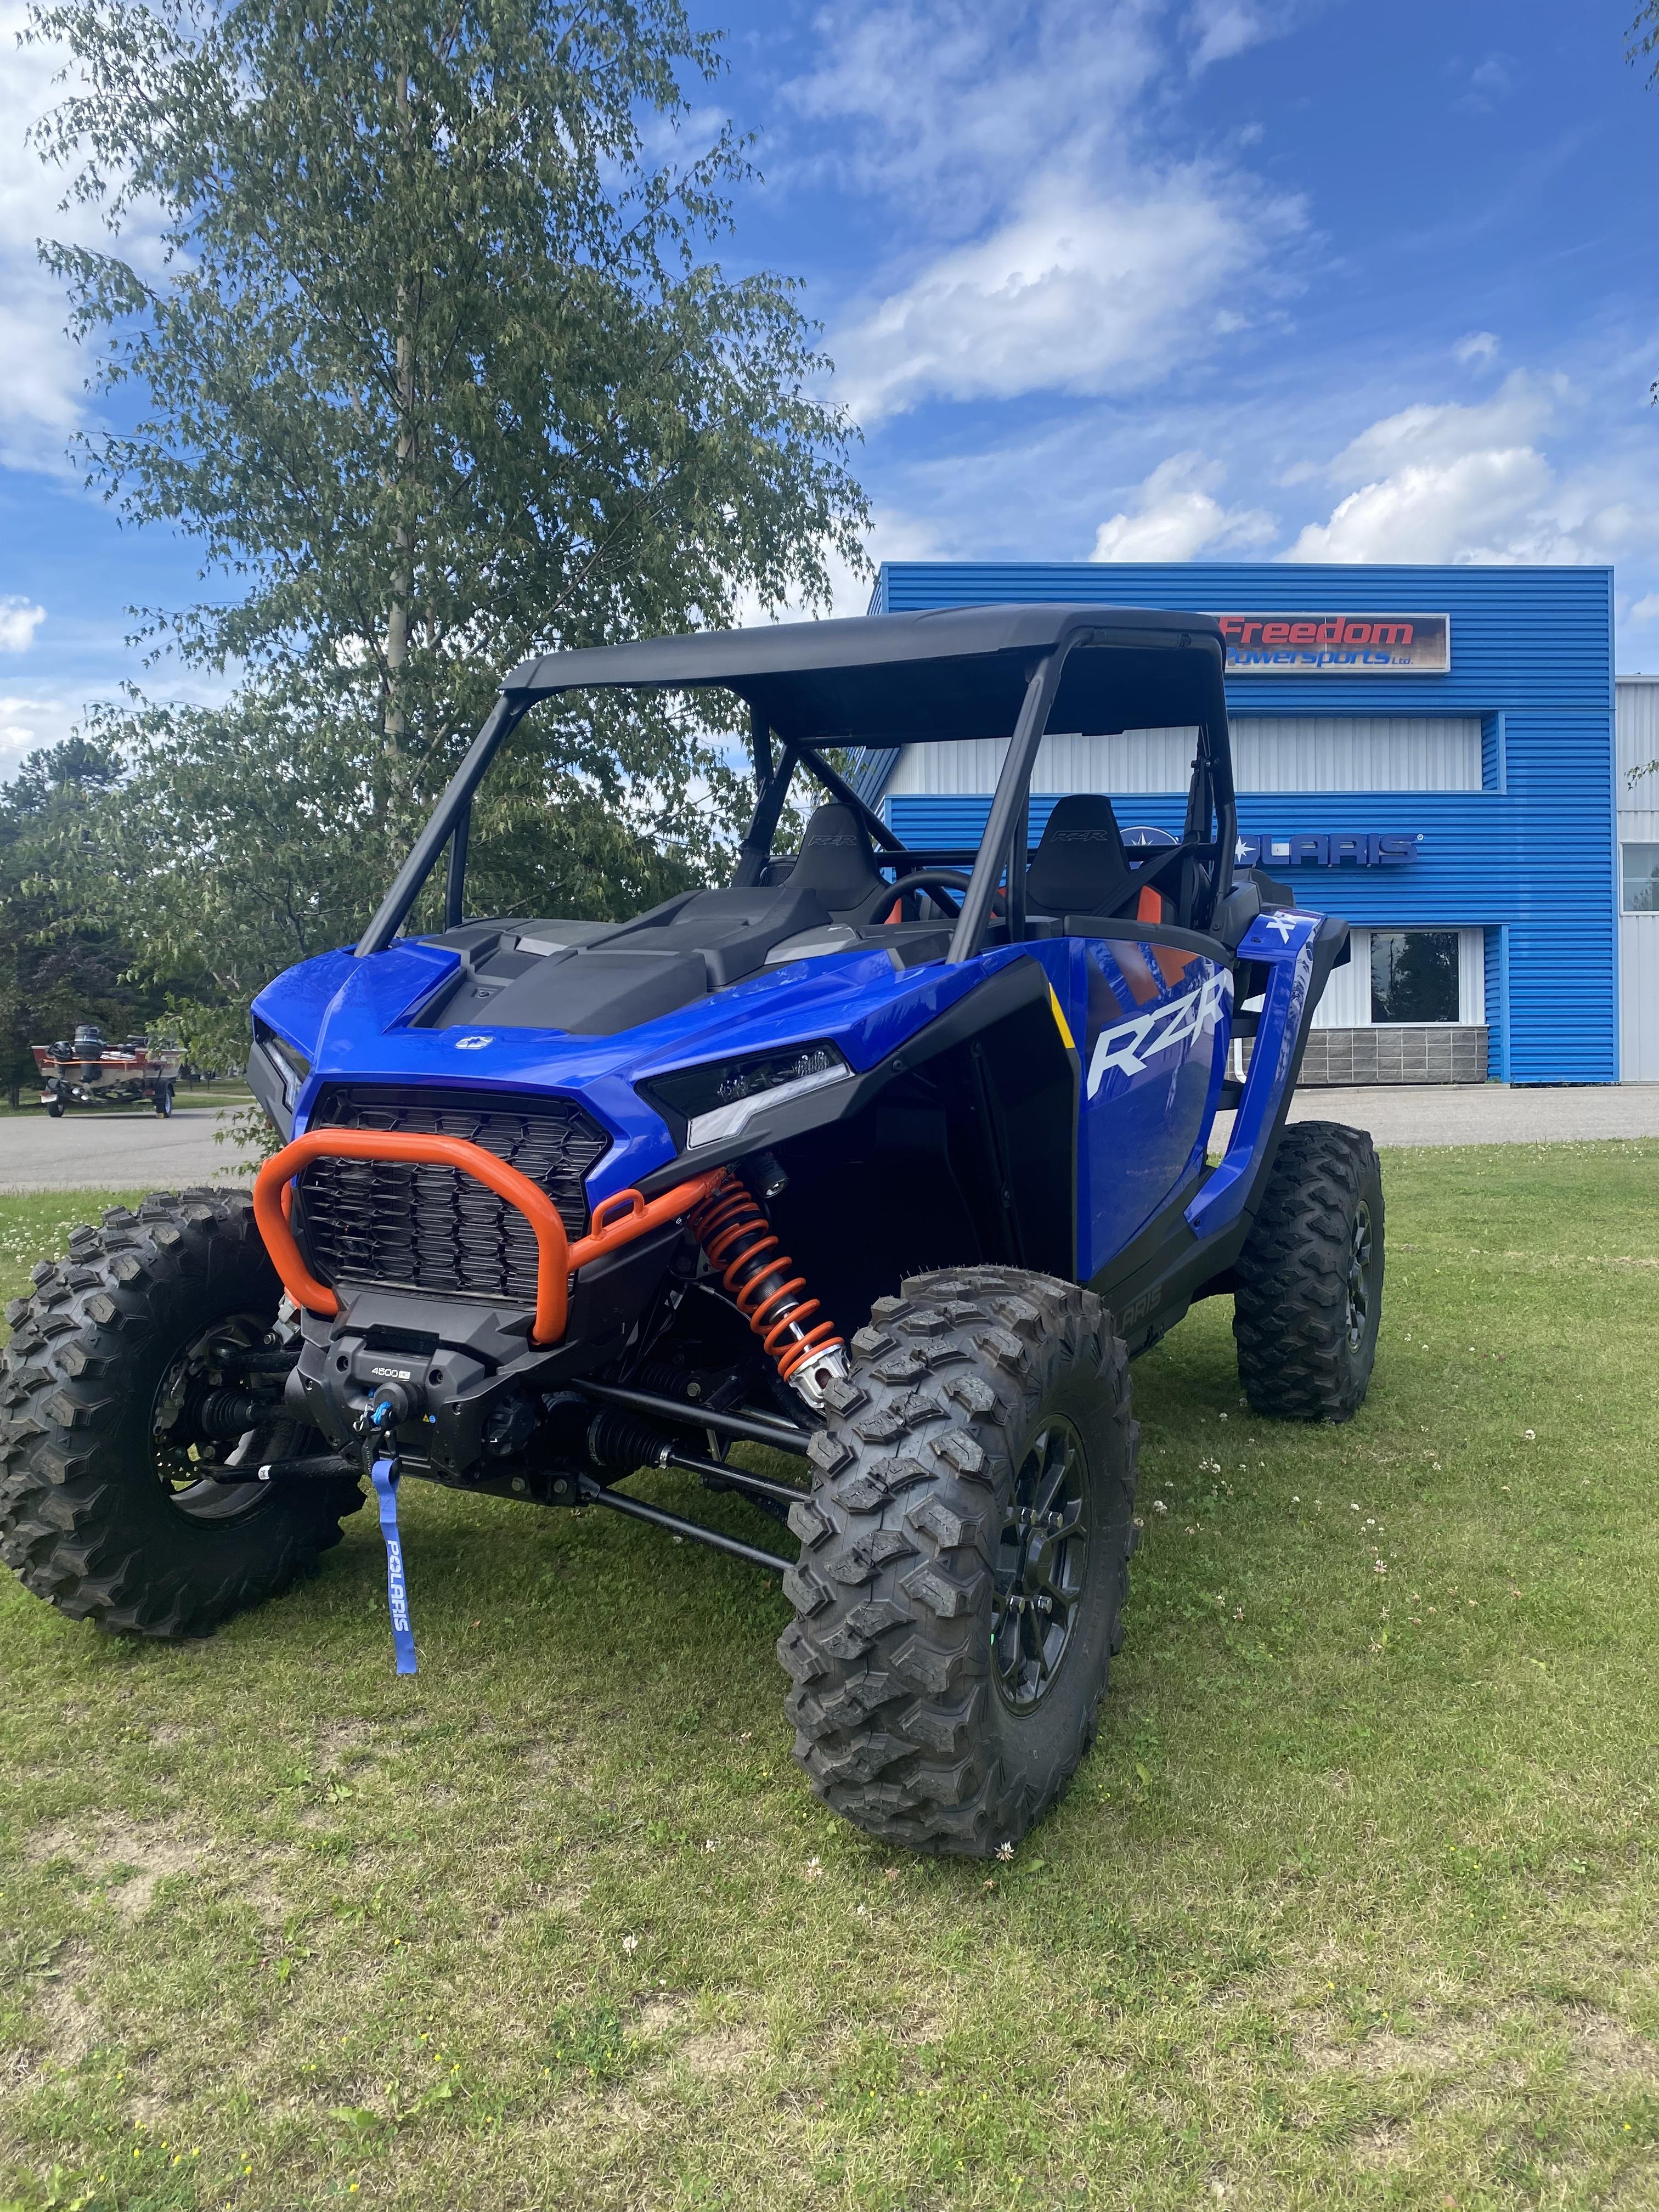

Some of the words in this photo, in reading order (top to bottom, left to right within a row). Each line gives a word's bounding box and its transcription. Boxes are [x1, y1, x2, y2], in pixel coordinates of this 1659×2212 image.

[1219, 616, 1414, 644] Freedom
[808, 835, 857, 847] RZR
[1050, 830, 1108, 842] RZR
[1211, 833, 1418, 865] OLARIS
[1087, 968, 1224, 1101] RZR
[1114, 1284, 1163, 1337] LARIS
[371, 1367, 398, 1378] 4500
[387, 1540, 409, 1632] POLARIS
